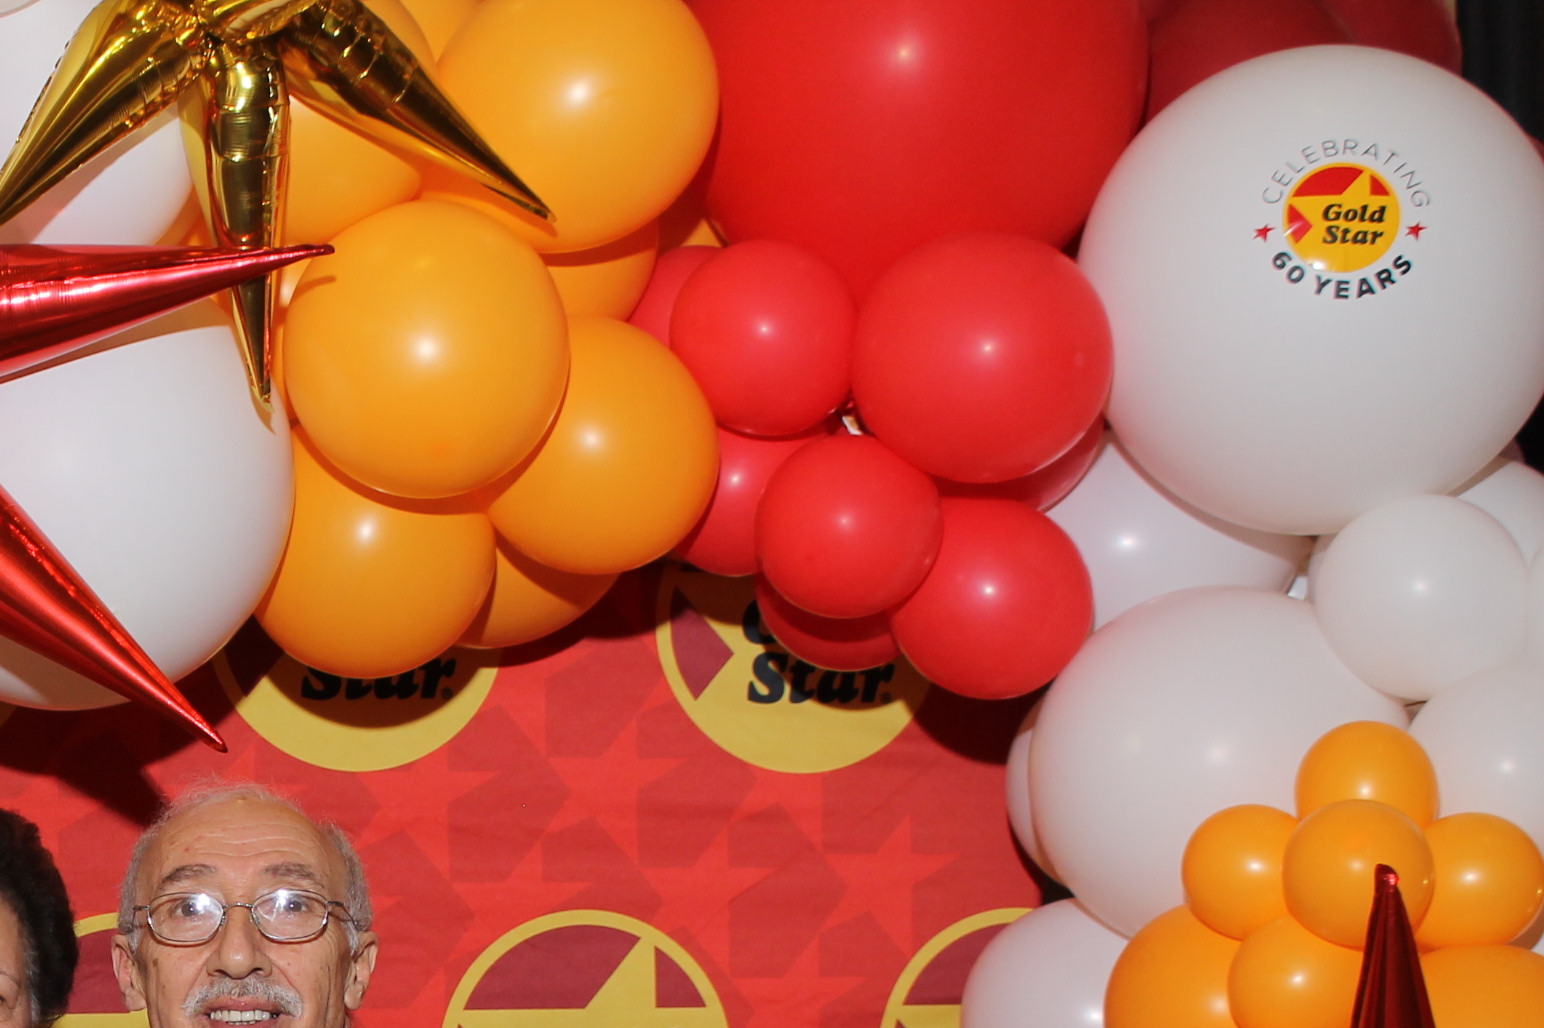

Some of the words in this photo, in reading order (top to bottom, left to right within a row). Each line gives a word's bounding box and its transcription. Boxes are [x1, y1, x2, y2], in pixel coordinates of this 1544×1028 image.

[1262, 138, 1430, 208] CELEBRATING
[1322, 203, 1387, 223] Gold
[1322, 225, 1384, 245] Star
[1272, 251, 1306, 285] 60
[1314, 254, 1413, 300] YEARS
